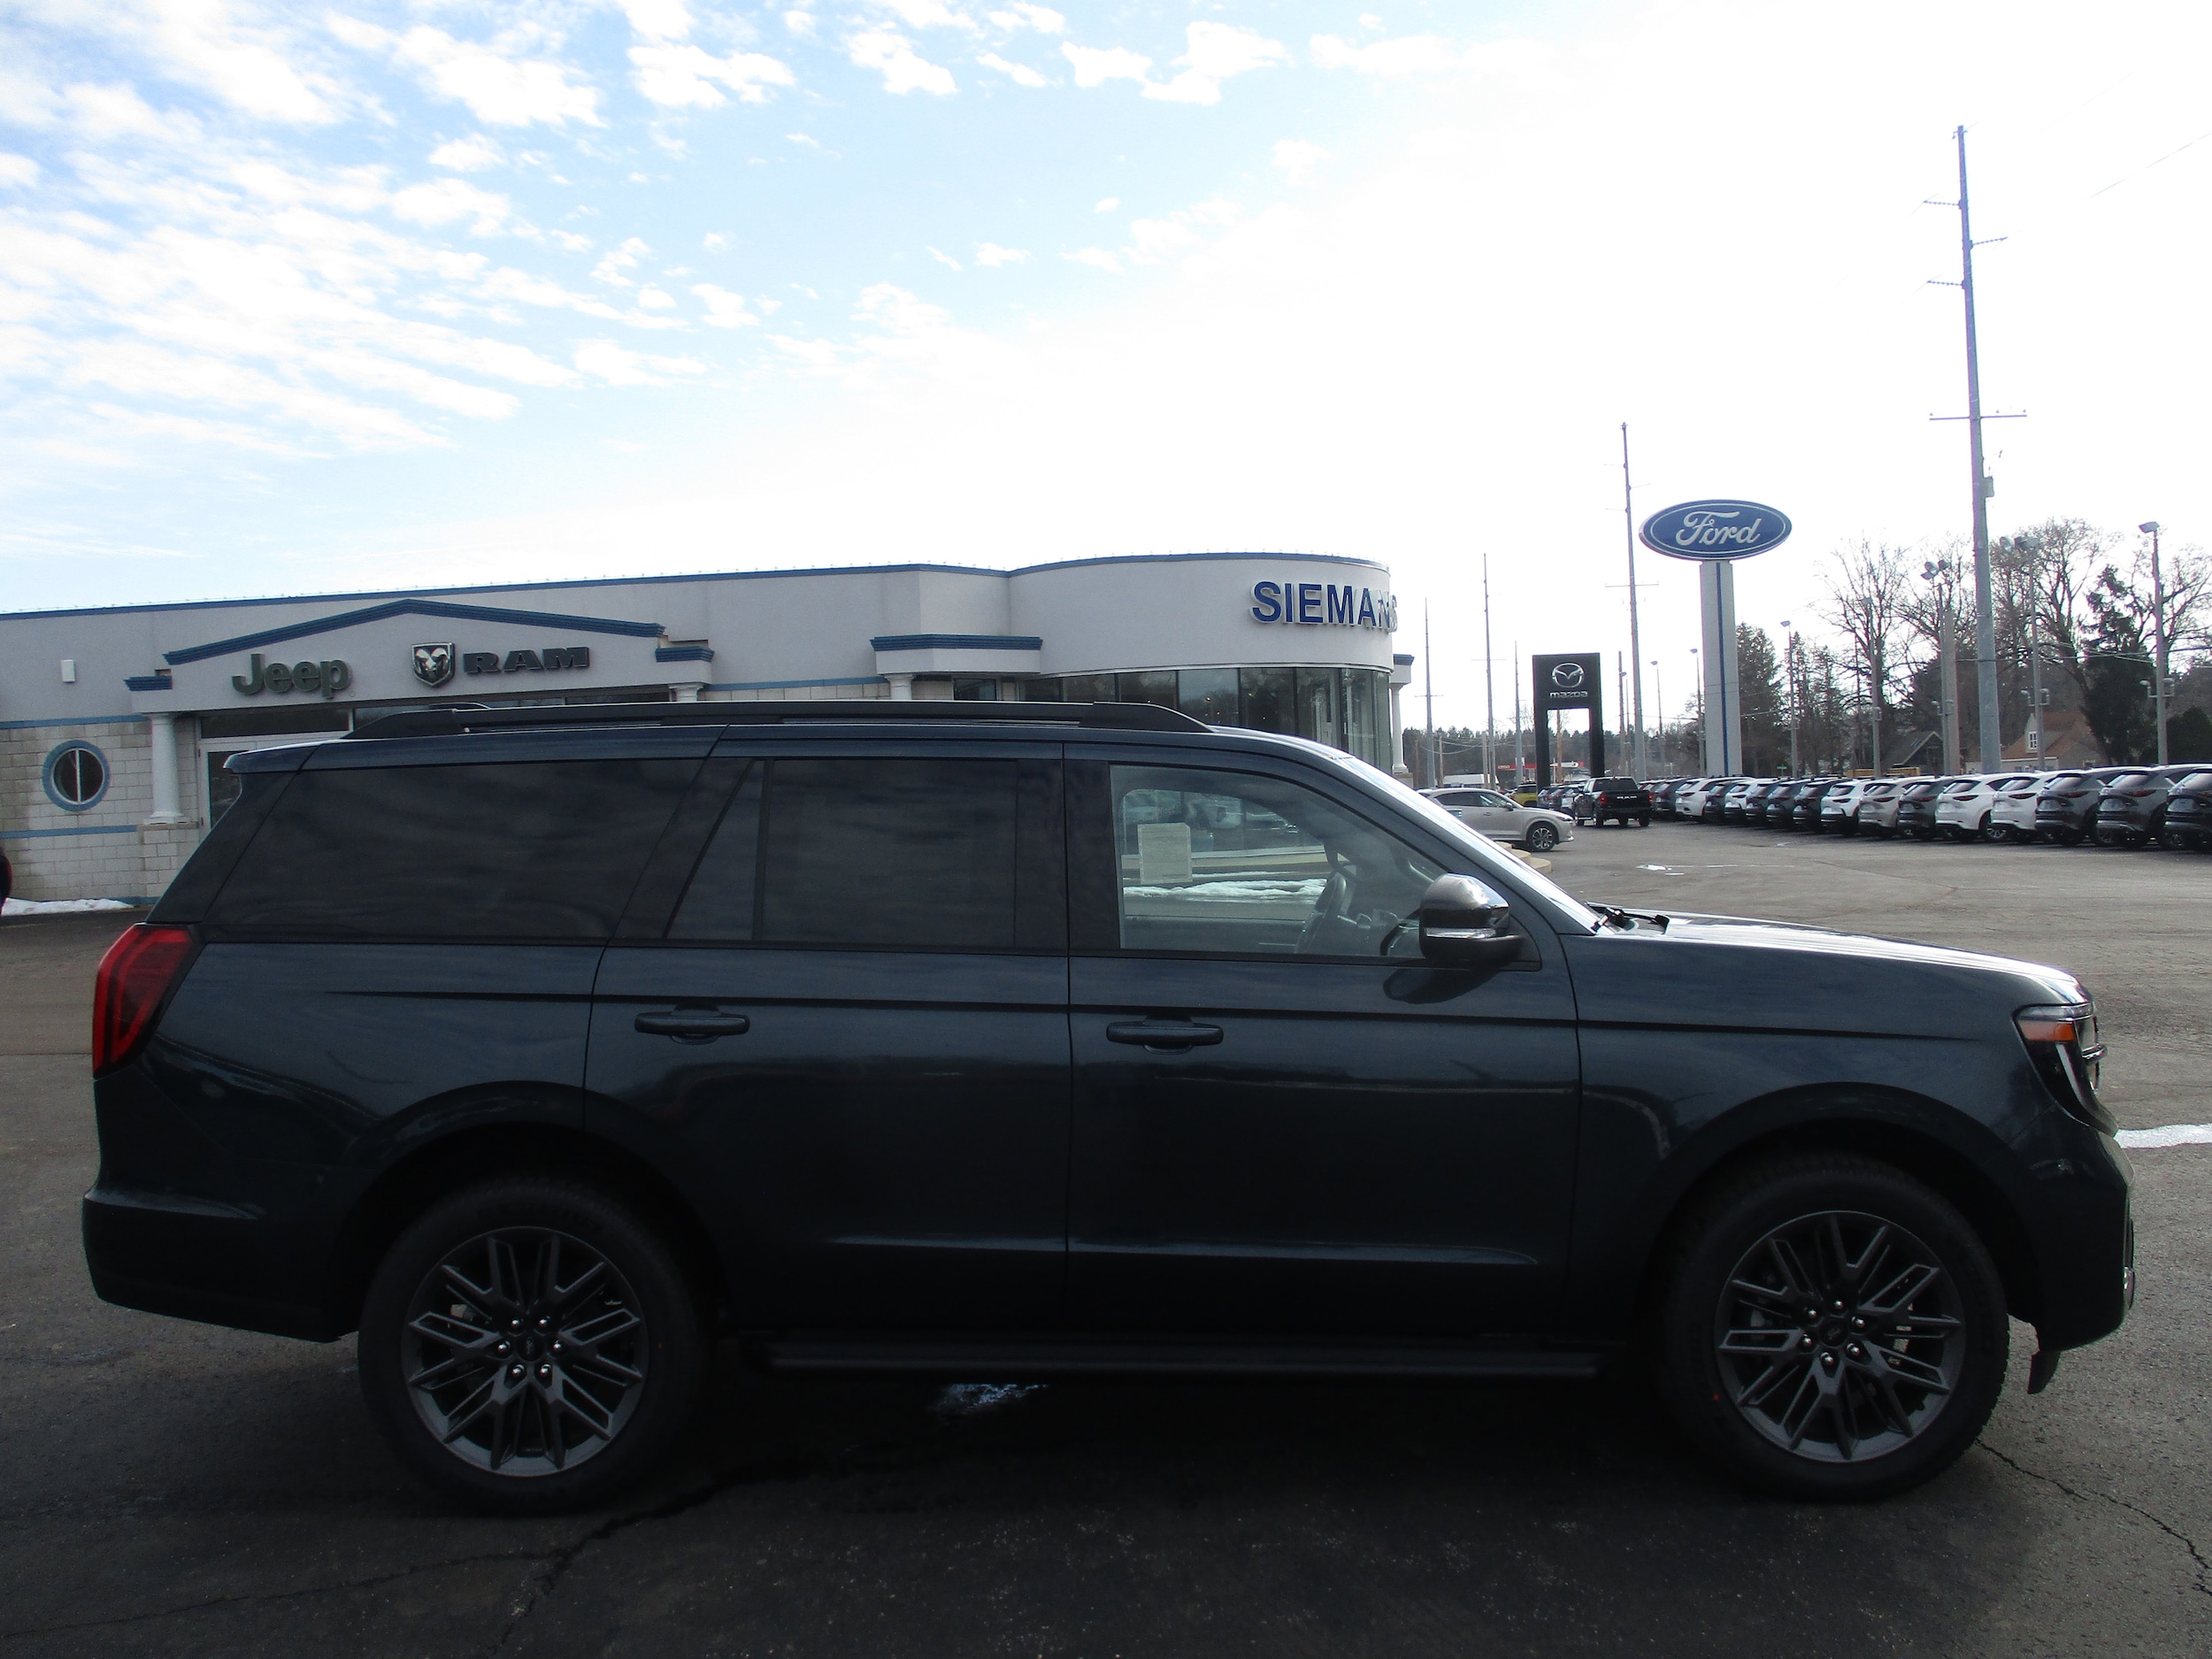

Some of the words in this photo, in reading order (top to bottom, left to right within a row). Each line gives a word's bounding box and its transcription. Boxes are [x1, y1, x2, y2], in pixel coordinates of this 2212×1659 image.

[1676, 511, 1762, 546] Ford
[231, 653, 353, 700] Jeep
[463, 646, 590, 674] RAM
